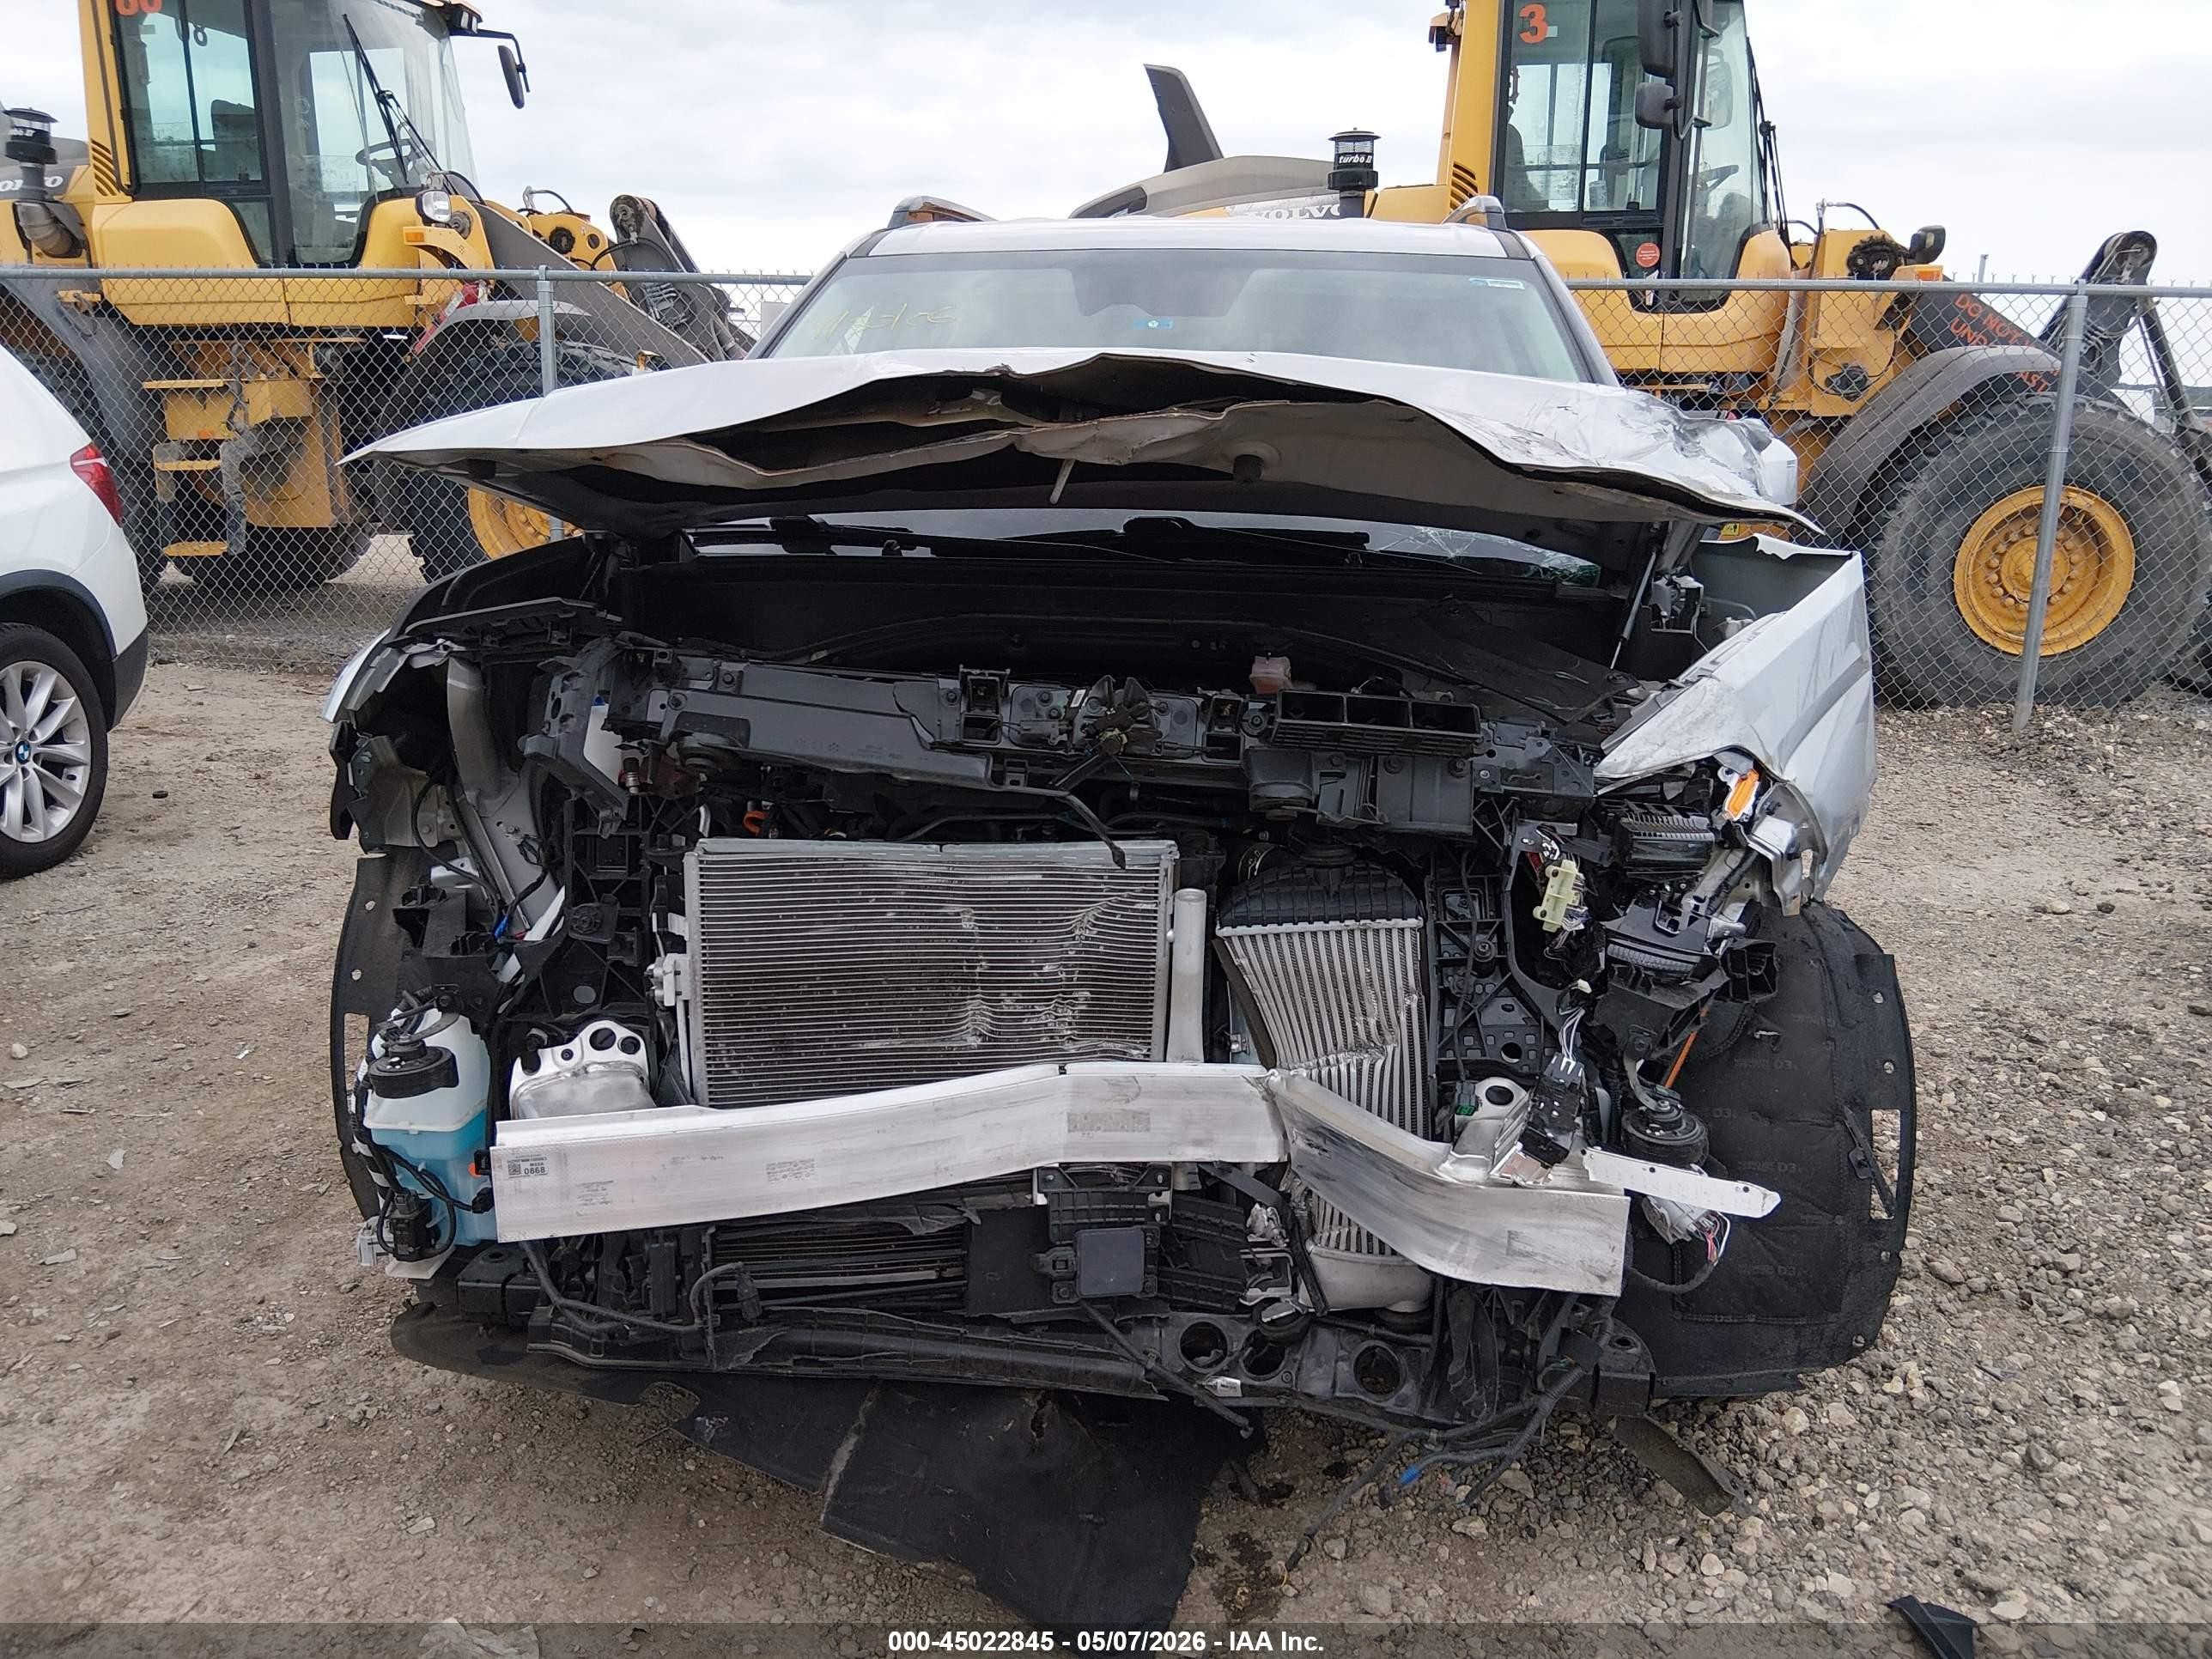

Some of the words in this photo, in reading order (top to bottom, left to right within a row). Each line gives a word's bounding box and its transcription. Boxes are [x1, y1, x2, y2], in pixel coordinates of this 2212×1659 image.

[1518, 3, 1548, 43] 3
[1339, 155, 1365, 164] turbo
[1954, 293, 1983, 318] DO
